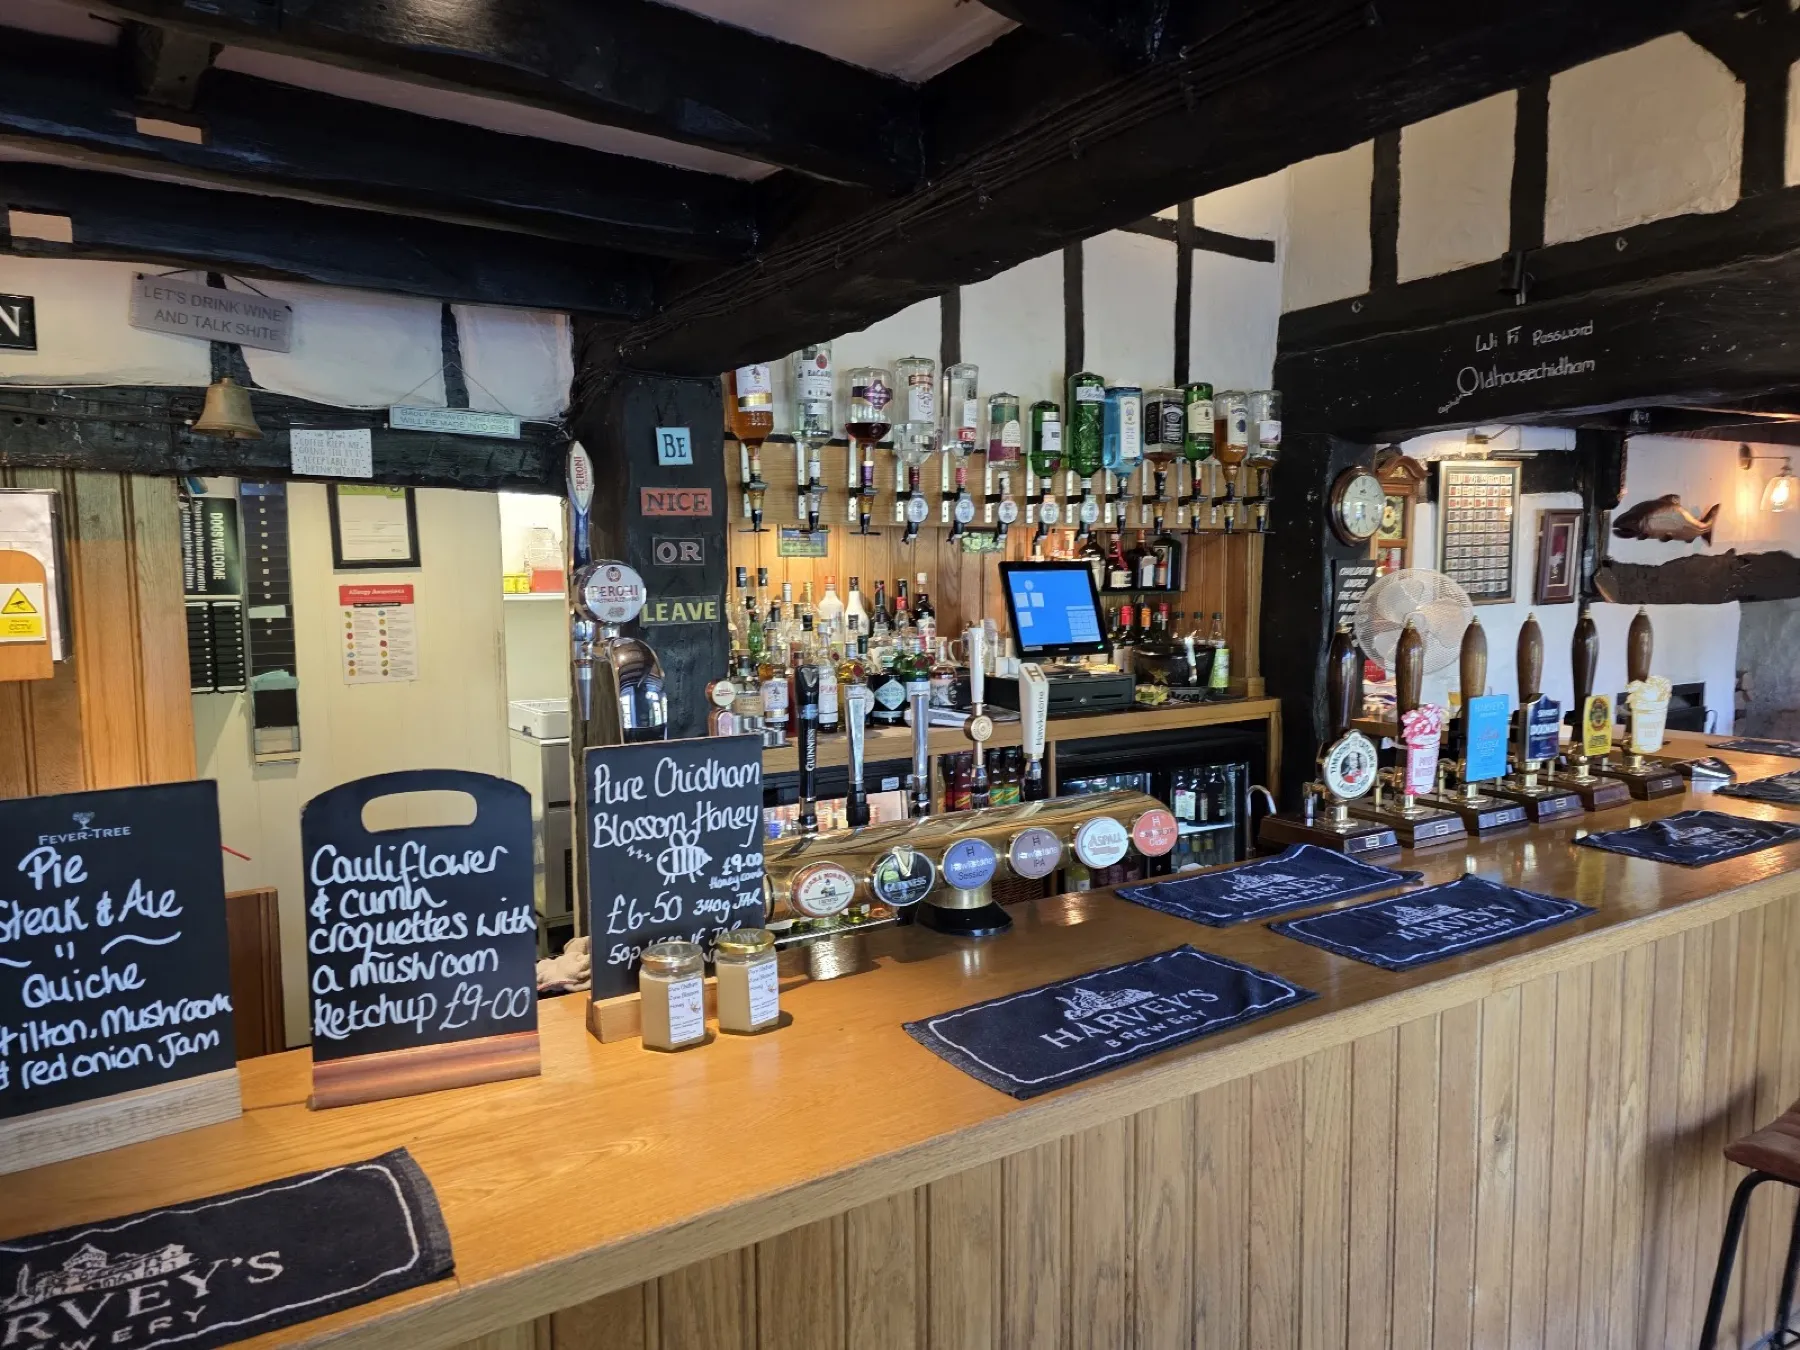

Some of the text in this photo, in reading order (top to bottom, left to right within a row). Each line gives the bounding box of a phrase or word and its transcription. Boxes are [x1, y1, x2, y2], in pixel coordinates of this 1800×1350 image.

[144, 286, 282, 322] LET'S DRINK WINE
[154, 309, 280, 341] AND TALK SHITE
[1532, 319, 1594, 346] Password
[401, 417, 423, 425] WILL
[425, 418, 437, 426] BE
[662, 433, 687, 458] BE
[573, 455, 585, 491] PERONI
[646, 492, 708, 512] NICE
[209, 512, 226, 580] DOGS WELCOME
[656, 541, 702, 563] OR
[641, 600, 718, 622] LEAVE
[804, 728, 816, 772] GUINNESS
[593, 756, 760, 805] Pure Chidham
[38, 825, 132, 846] FEVER-TREE
[592, 801, 760, 849] Blossom Honey
[17, 845, 89, 891] Pie
[310, 840, 509, 894] Cauliflower
[1033, 858, 1046, 868] IPA
[0, 878, 184, 942] Steak & Ale
[310, 878, 448, 925] & cumin
[692, 898, 731, 924] 340g
[731, 887, 763, 910] JAR
[308, 897, 538, 965] croquettes with
[22, 962, 147, 1009] Quiche
[312, 948, 499, 995] a mushroom
[99, 992, 233, 1039] Mushroom
[314, 991, 437, 1040] Ketchup
[1039, 988, 1220, 1049] HARVEY'S
[1104, 1008, 1207, 1049] BREWERY
[21, 1052, 68, 1090] red
[71, 1043, 154, 1078] onion
[158, 1029, 220, 1069] Jam
